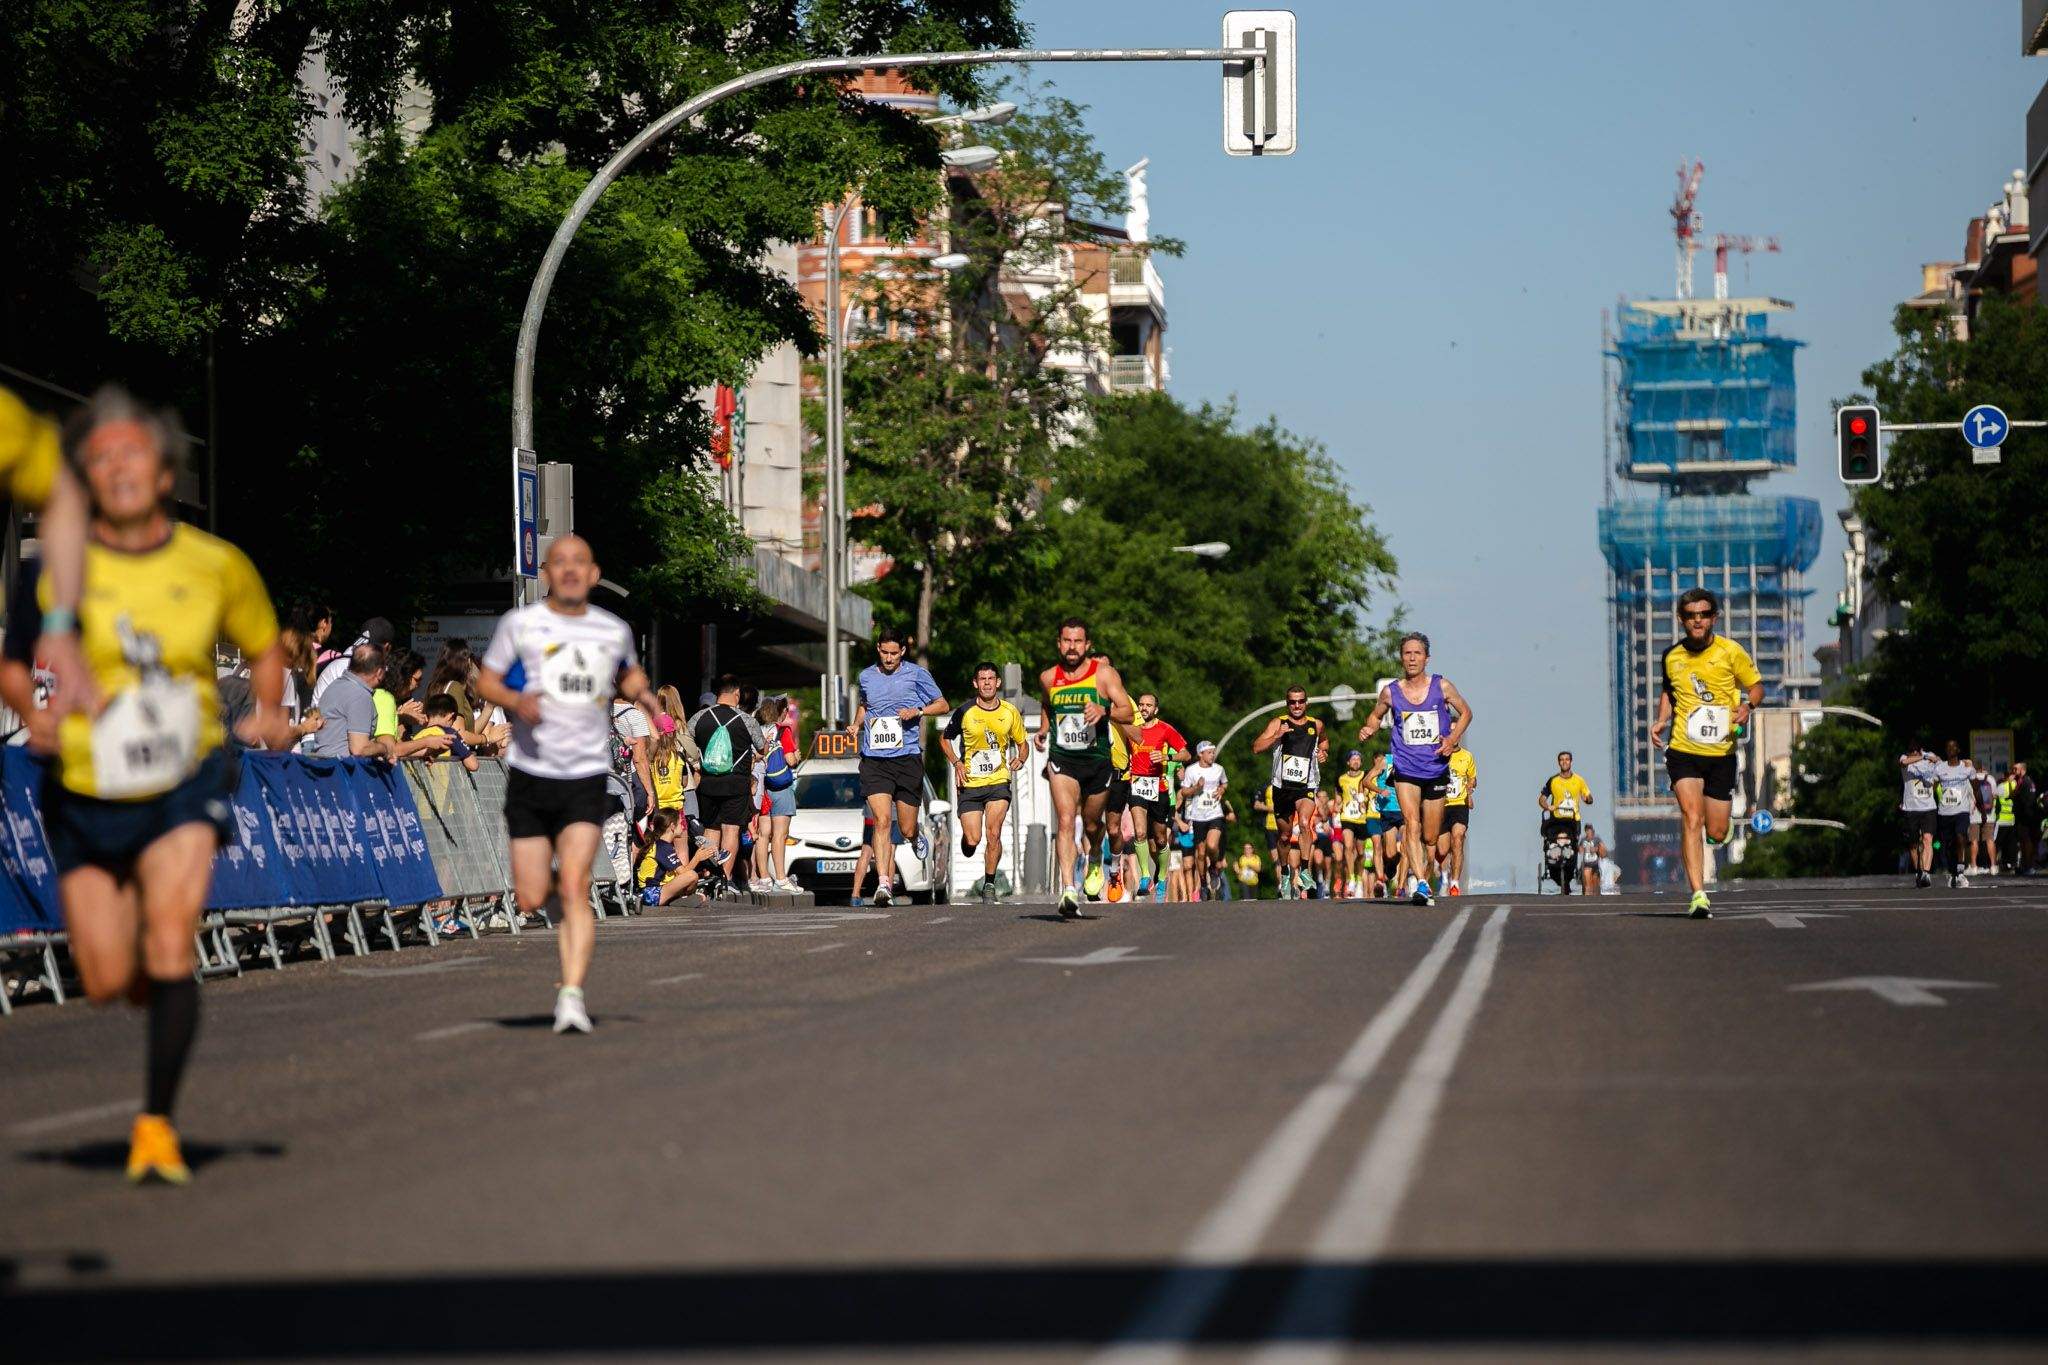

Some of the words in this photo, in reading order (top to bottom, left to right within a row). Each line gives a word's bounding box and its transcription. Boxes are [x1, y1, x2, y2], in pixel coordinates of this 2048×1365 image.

[1410, 729, 1432, 739] 1234
[1701, 725, 1718, 736] 671
[874, 733, 896, 744] 3008
[818, 734, 858, 755] 00:4
[979, 763, 993, 772] 139
[824, 862, 848, 871] 0229
